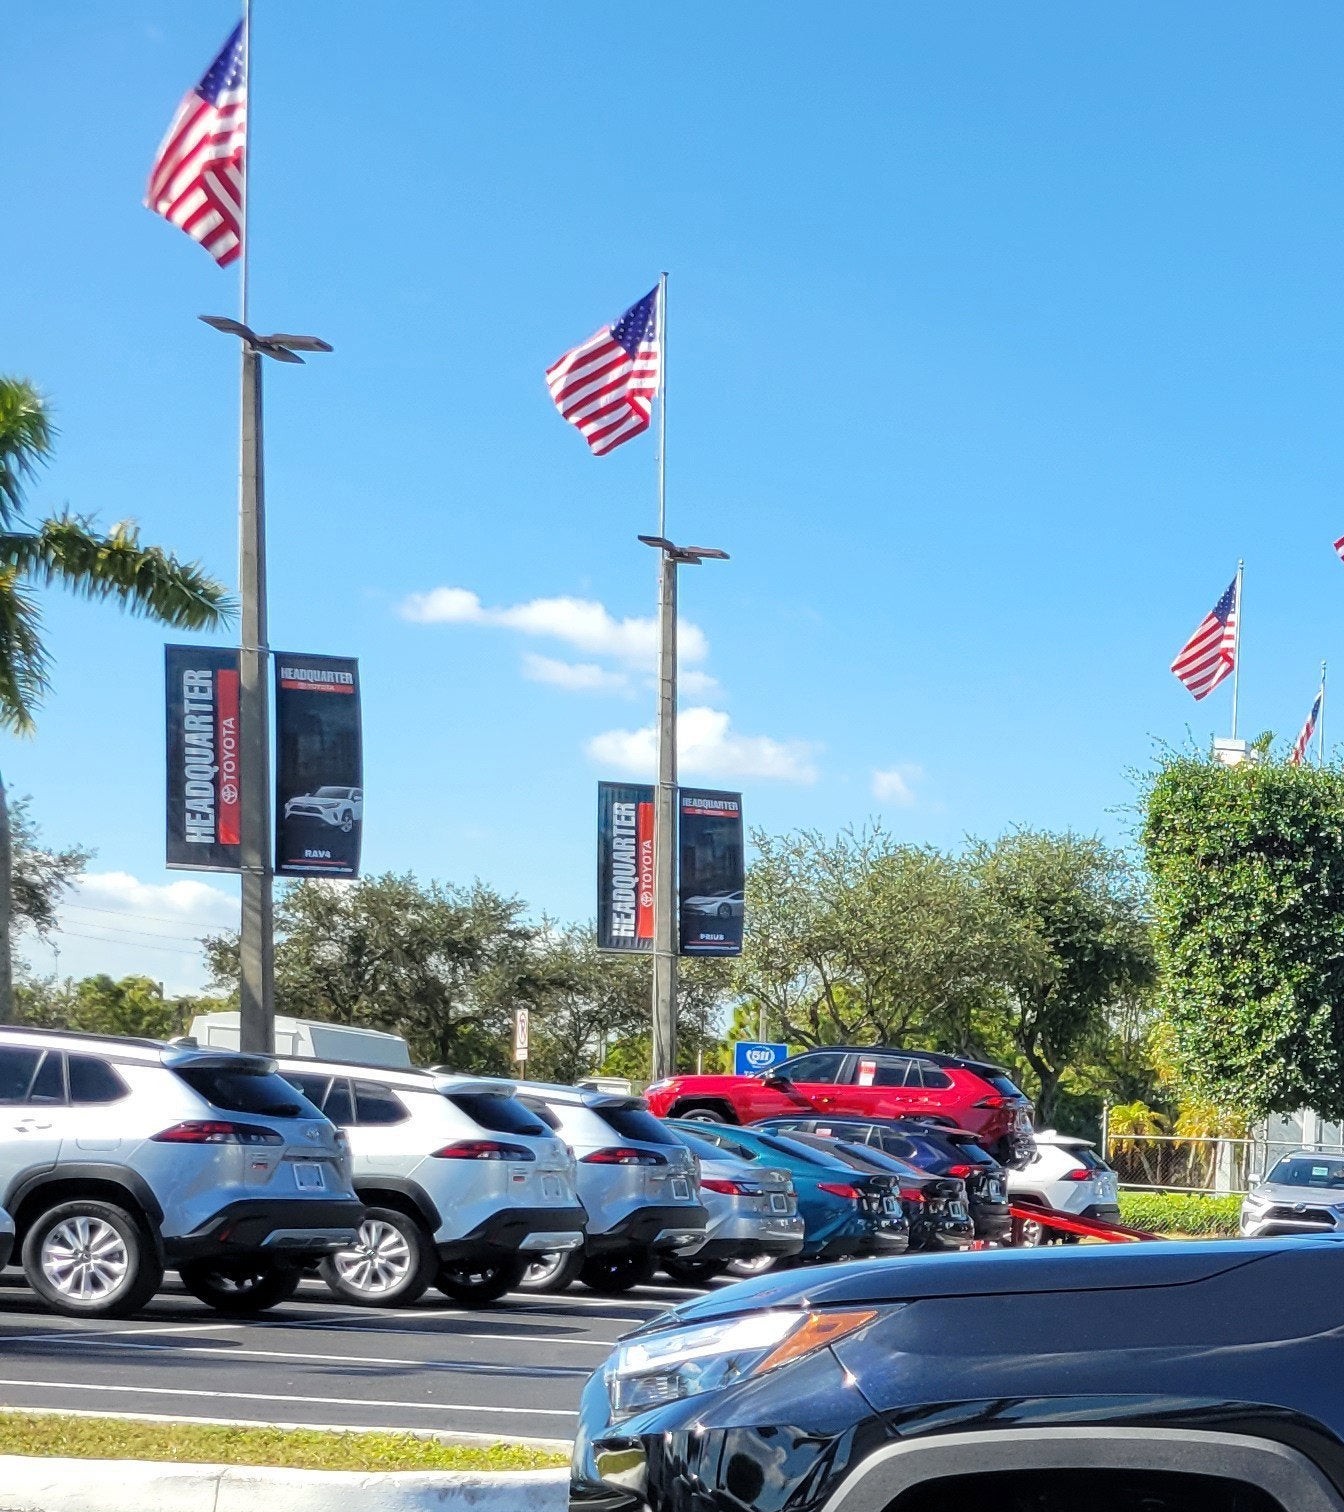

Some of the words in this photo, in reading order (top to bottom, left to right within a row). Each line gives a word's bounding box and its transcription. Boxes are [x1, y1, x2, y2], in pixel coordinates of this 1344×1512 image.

[281, 667, 354, 685] HEADQUARTER
[183, 669, 219, 844] HEADQUARTER
[221, 717, 237, 783] TOYOTA
[304, 849, 331, 859] RAV4
[612, 801, 639, 938] HEADQUARTER
[643, 840, 652, 891] TOYOTA
